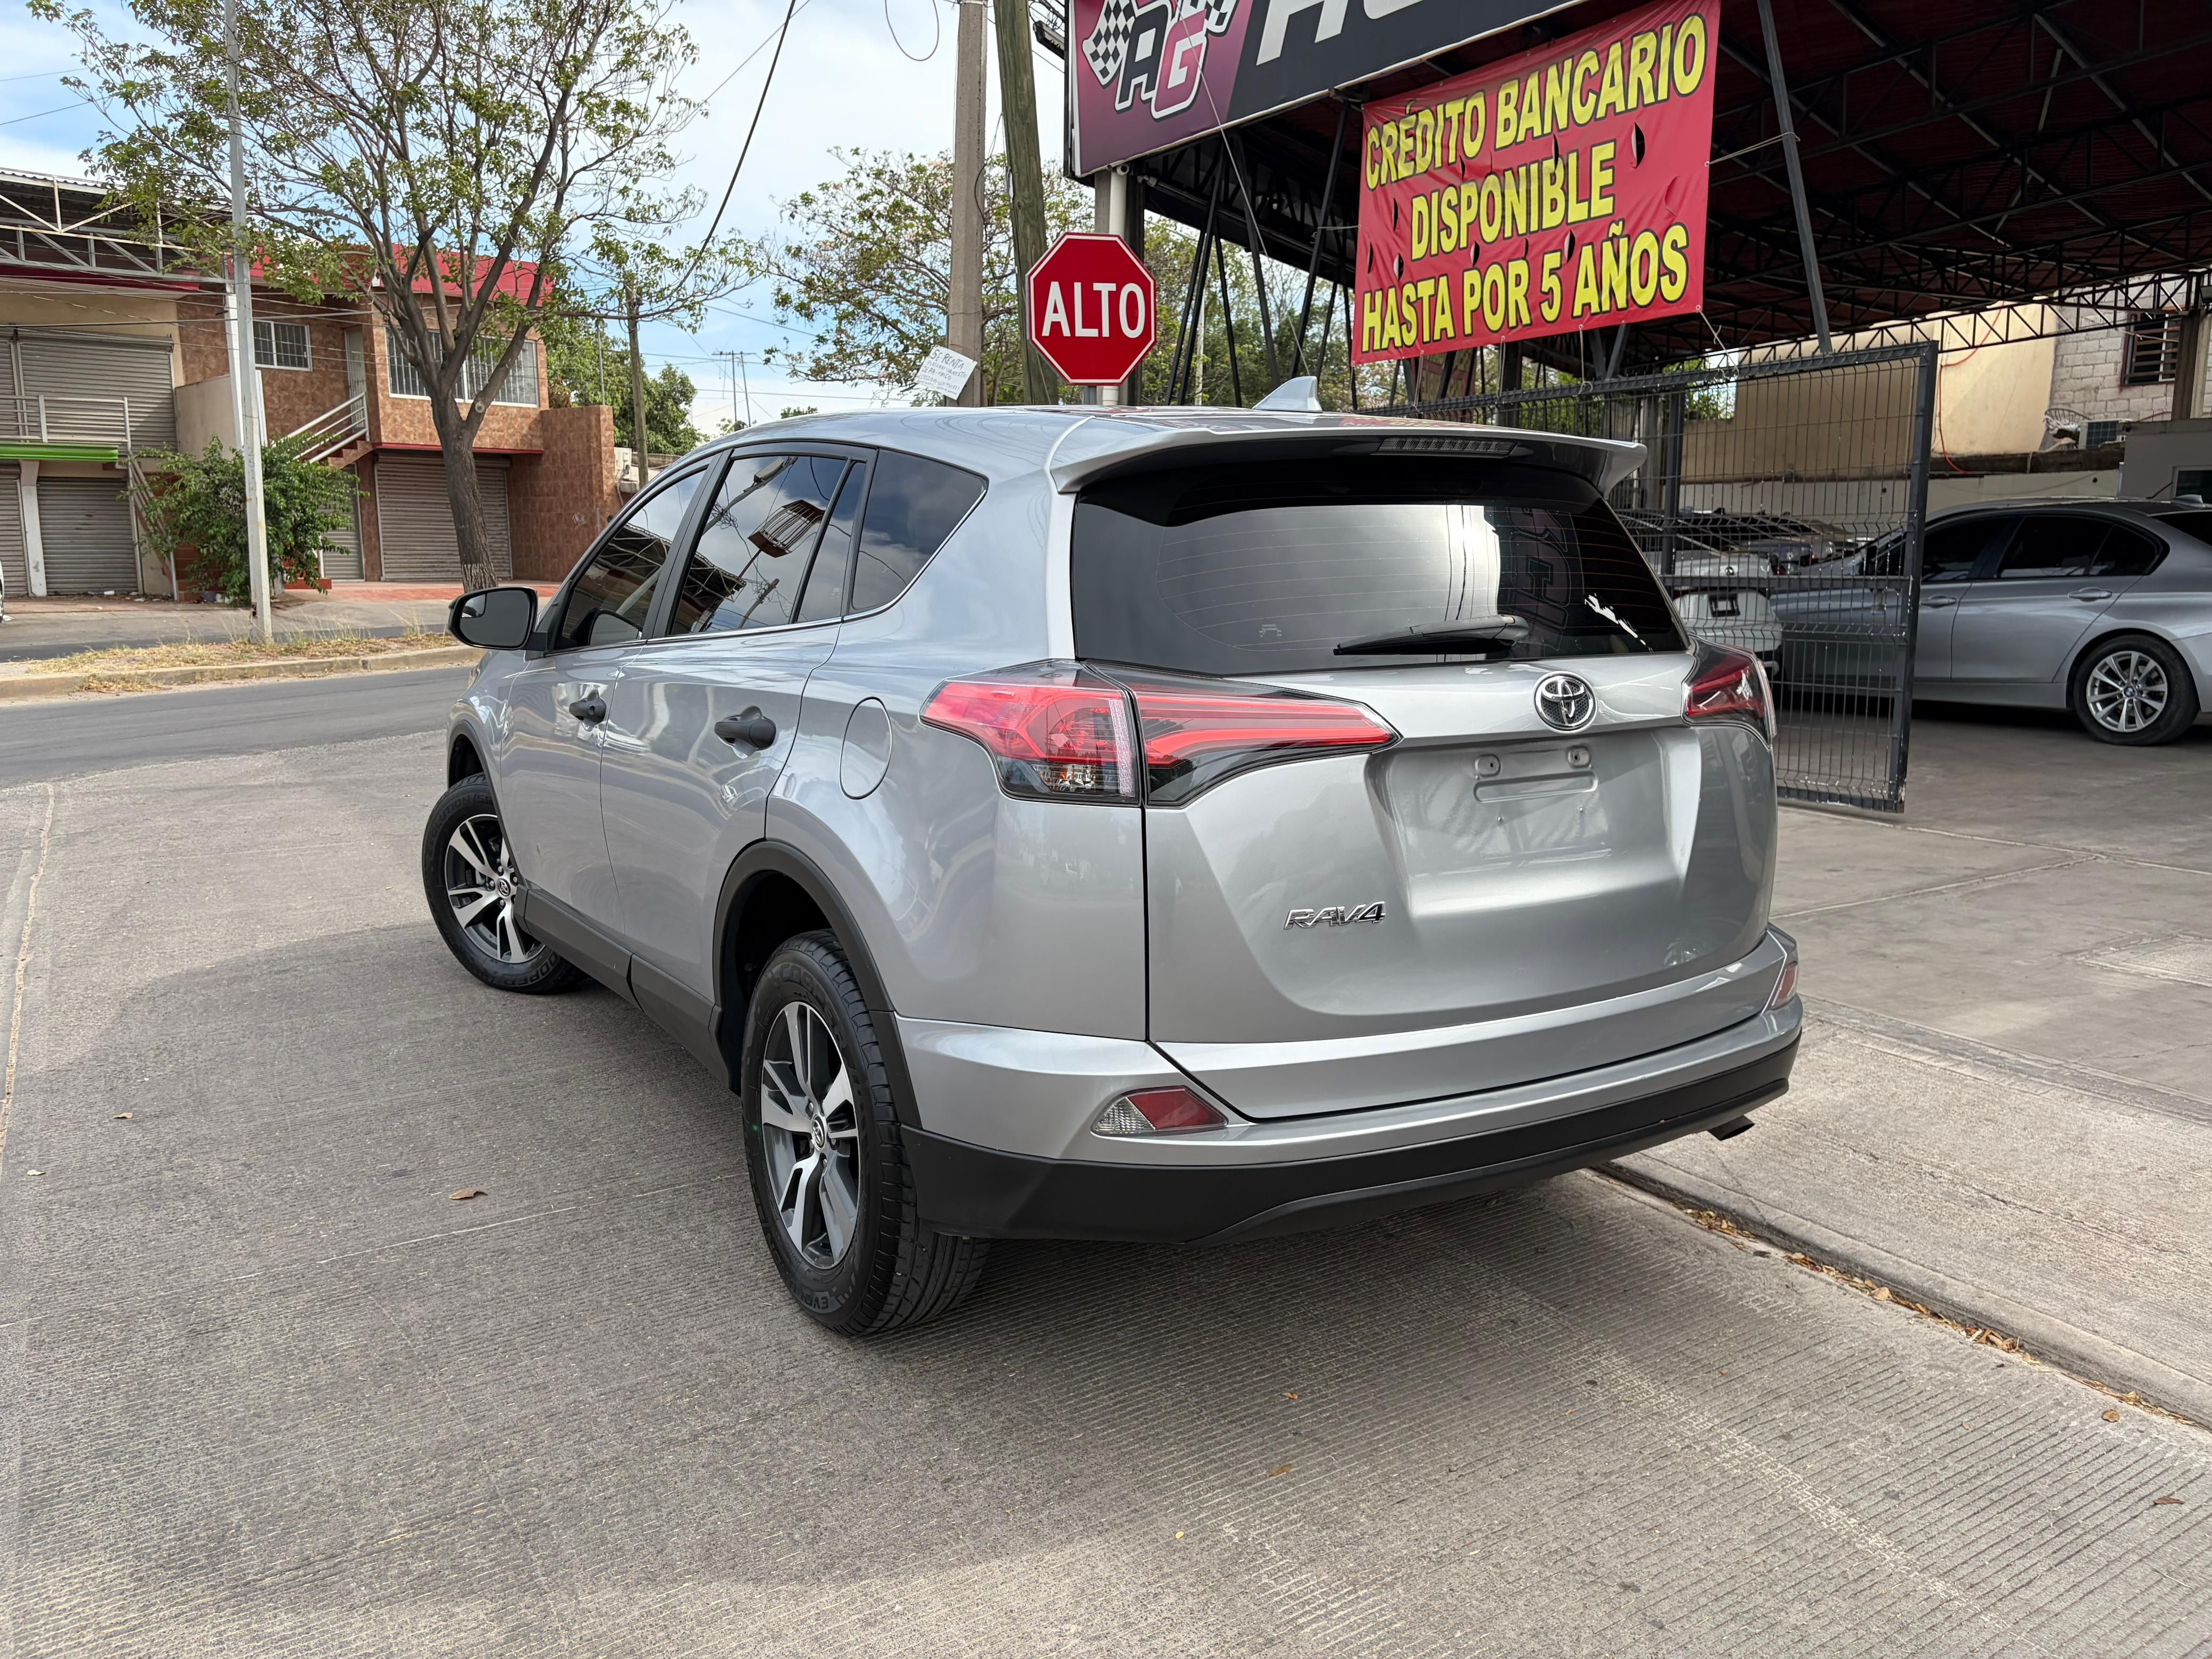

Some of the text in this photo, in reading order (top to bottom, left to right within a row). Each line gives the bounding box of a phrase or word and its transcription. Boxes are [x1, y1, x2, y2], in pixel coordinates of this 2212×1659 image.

[1115, 1, 1208, 119] AG
[1364, 99, 1486, 191] CRÉDITO
[1495, 13, 1706, 151] BANCARIO
[1411, 140, 1616, 262] DISPONIBLE
[1042, 281, 1145, 338] ALTO
[1361, 219, 1689, 353] HASTA POR 5 AÑOS
[942, 353, 965, 370] RENTA
[1283, 901, 1386, 929] RAV4
[504, 952, 559, 986] OOPER
